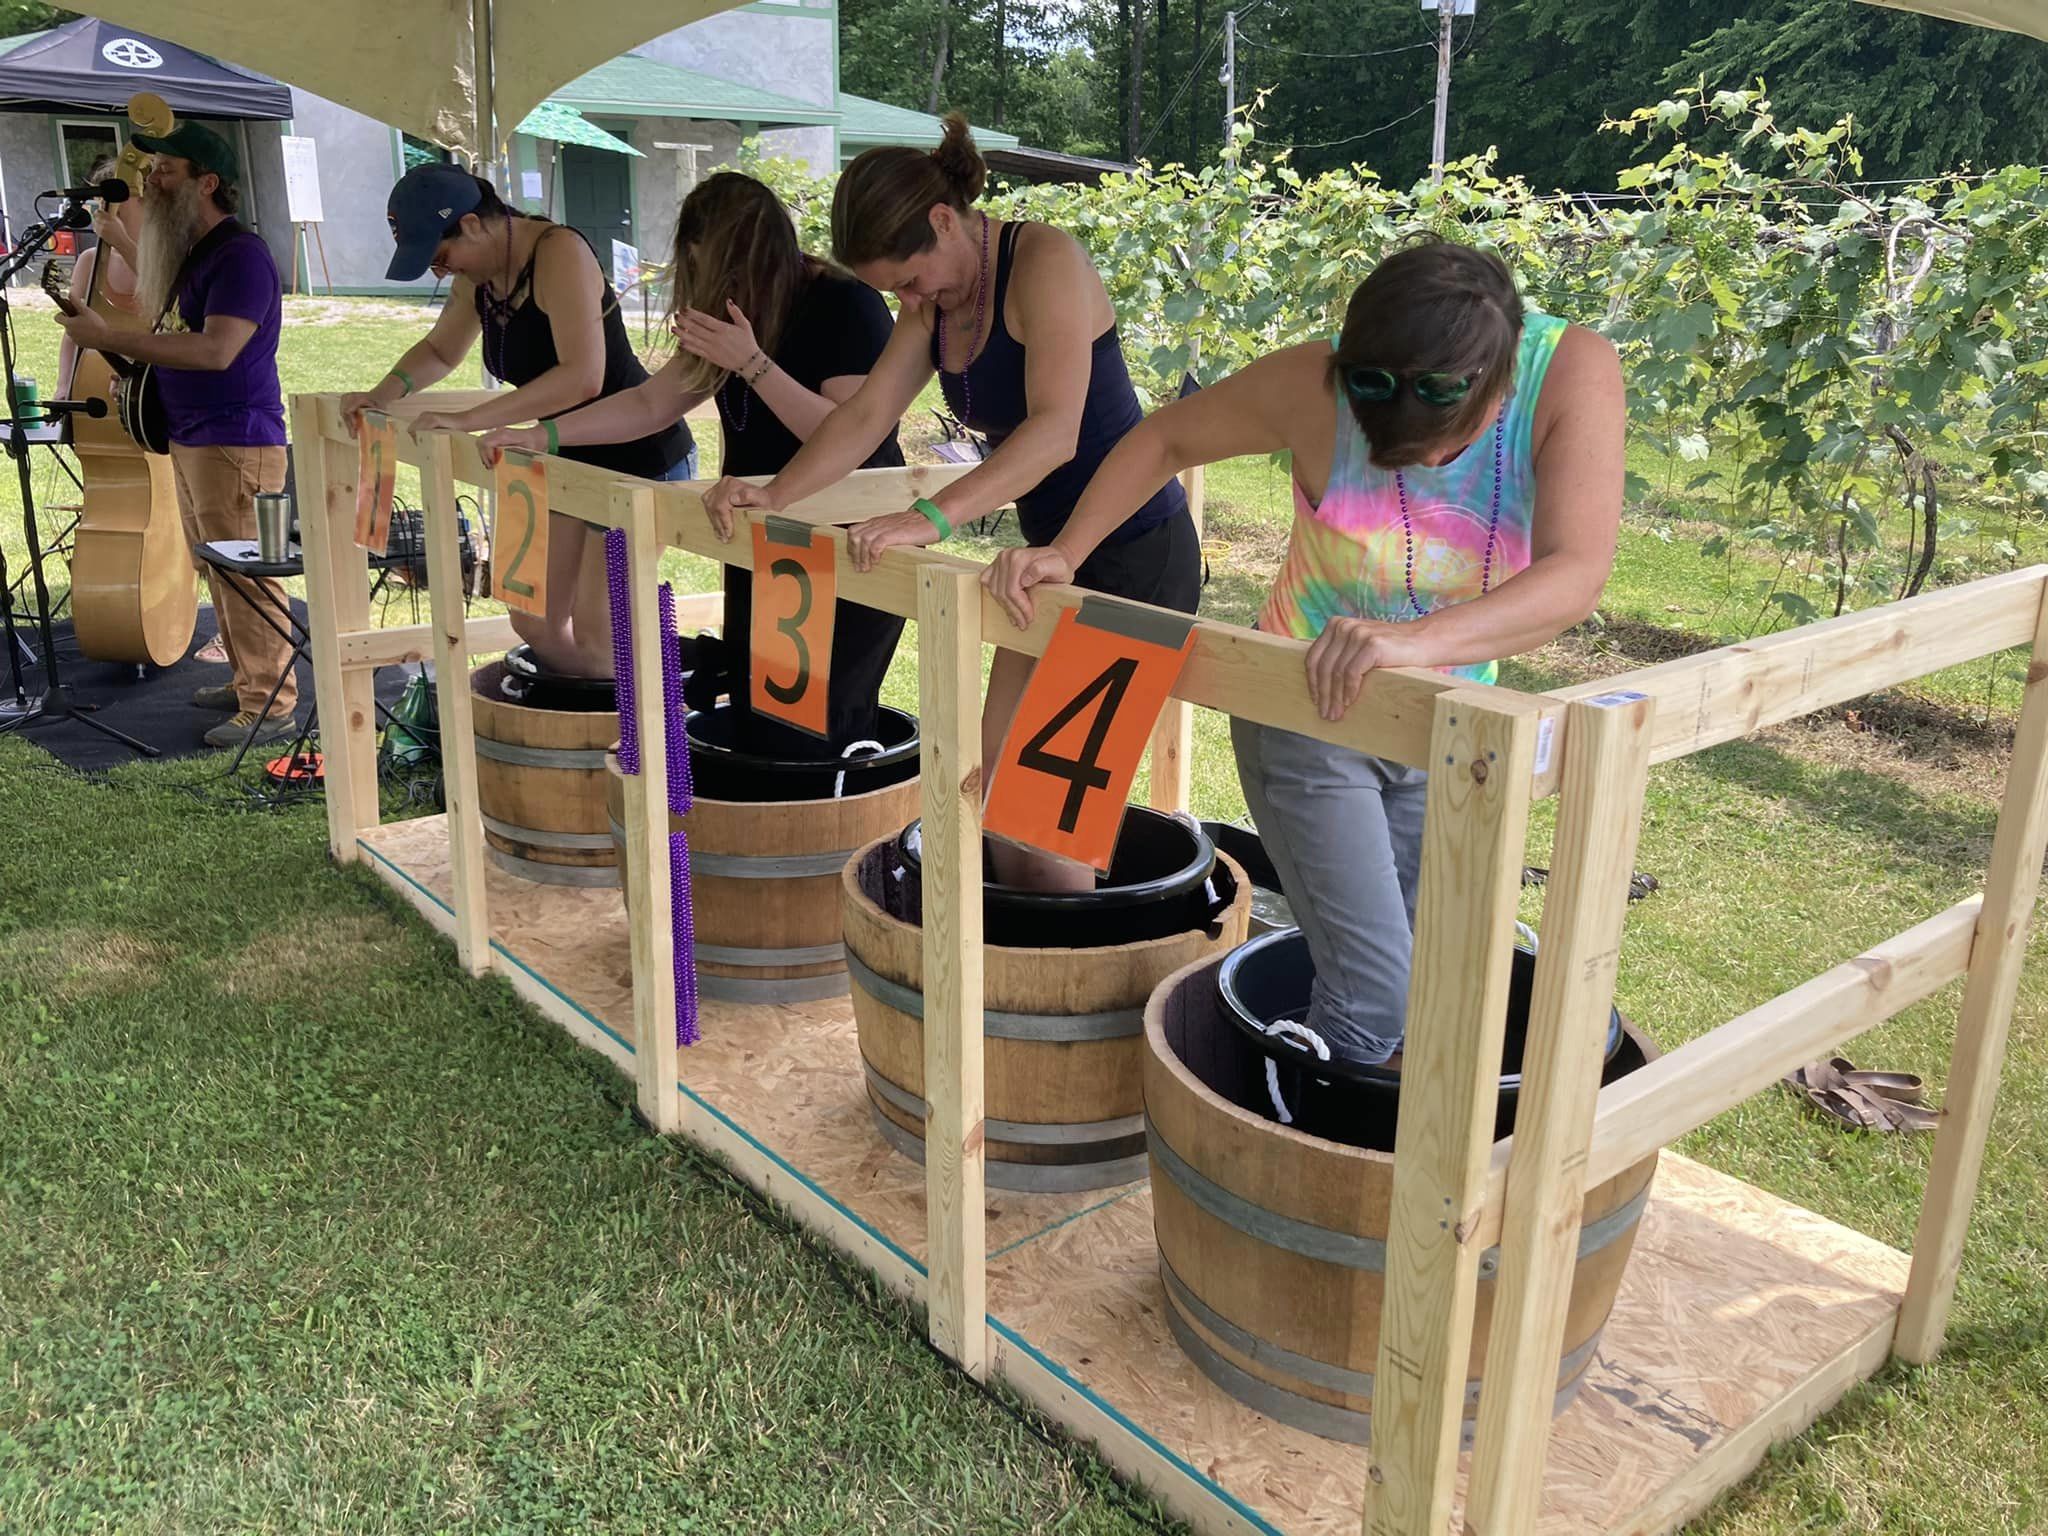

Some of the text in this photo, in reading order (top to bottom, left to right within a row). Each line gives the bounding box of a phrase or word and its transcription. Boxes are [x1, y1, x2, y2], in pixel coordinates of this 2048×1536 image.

[369, 440, 382, 536] 1
[502, 479, 536, 599] 2
[763, 558, 813, 704] 3
[1017, 658, 1139, 833] 4
